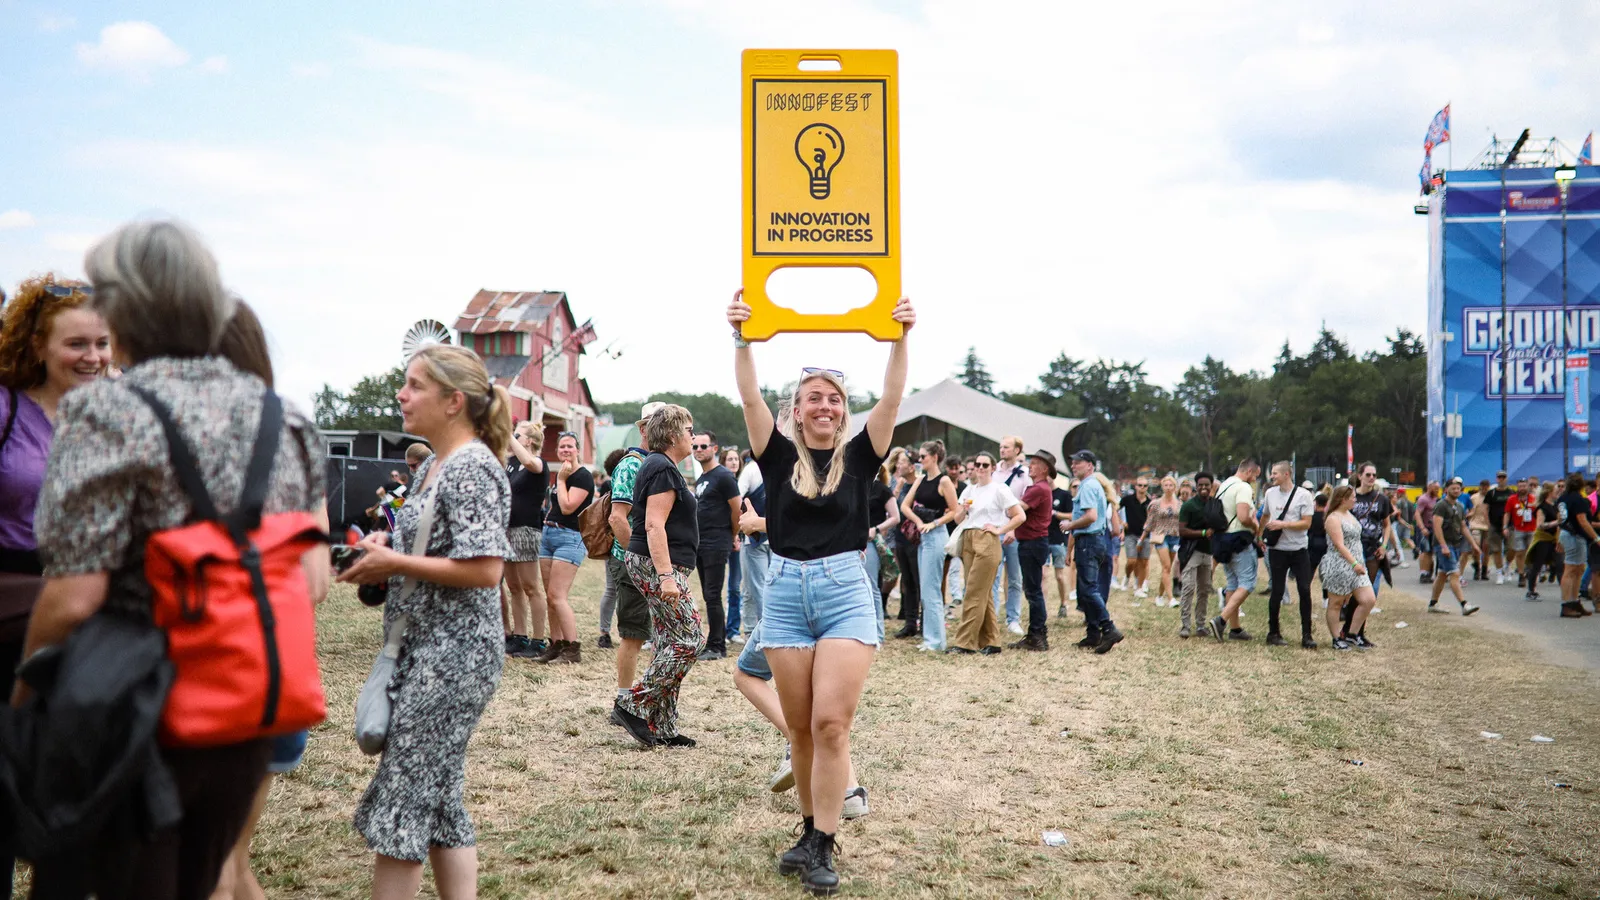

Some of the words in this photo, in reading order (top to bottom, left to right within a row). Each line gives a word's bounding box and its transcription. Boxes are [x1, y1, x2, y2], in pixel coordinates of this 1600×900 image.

[766, 93, 872, 112] INNOFEST
[770, 212, 870, 226] INNOVATION
[767, 228, 784, 242] IN
[789, 228, 873, 243] PROGRESS
